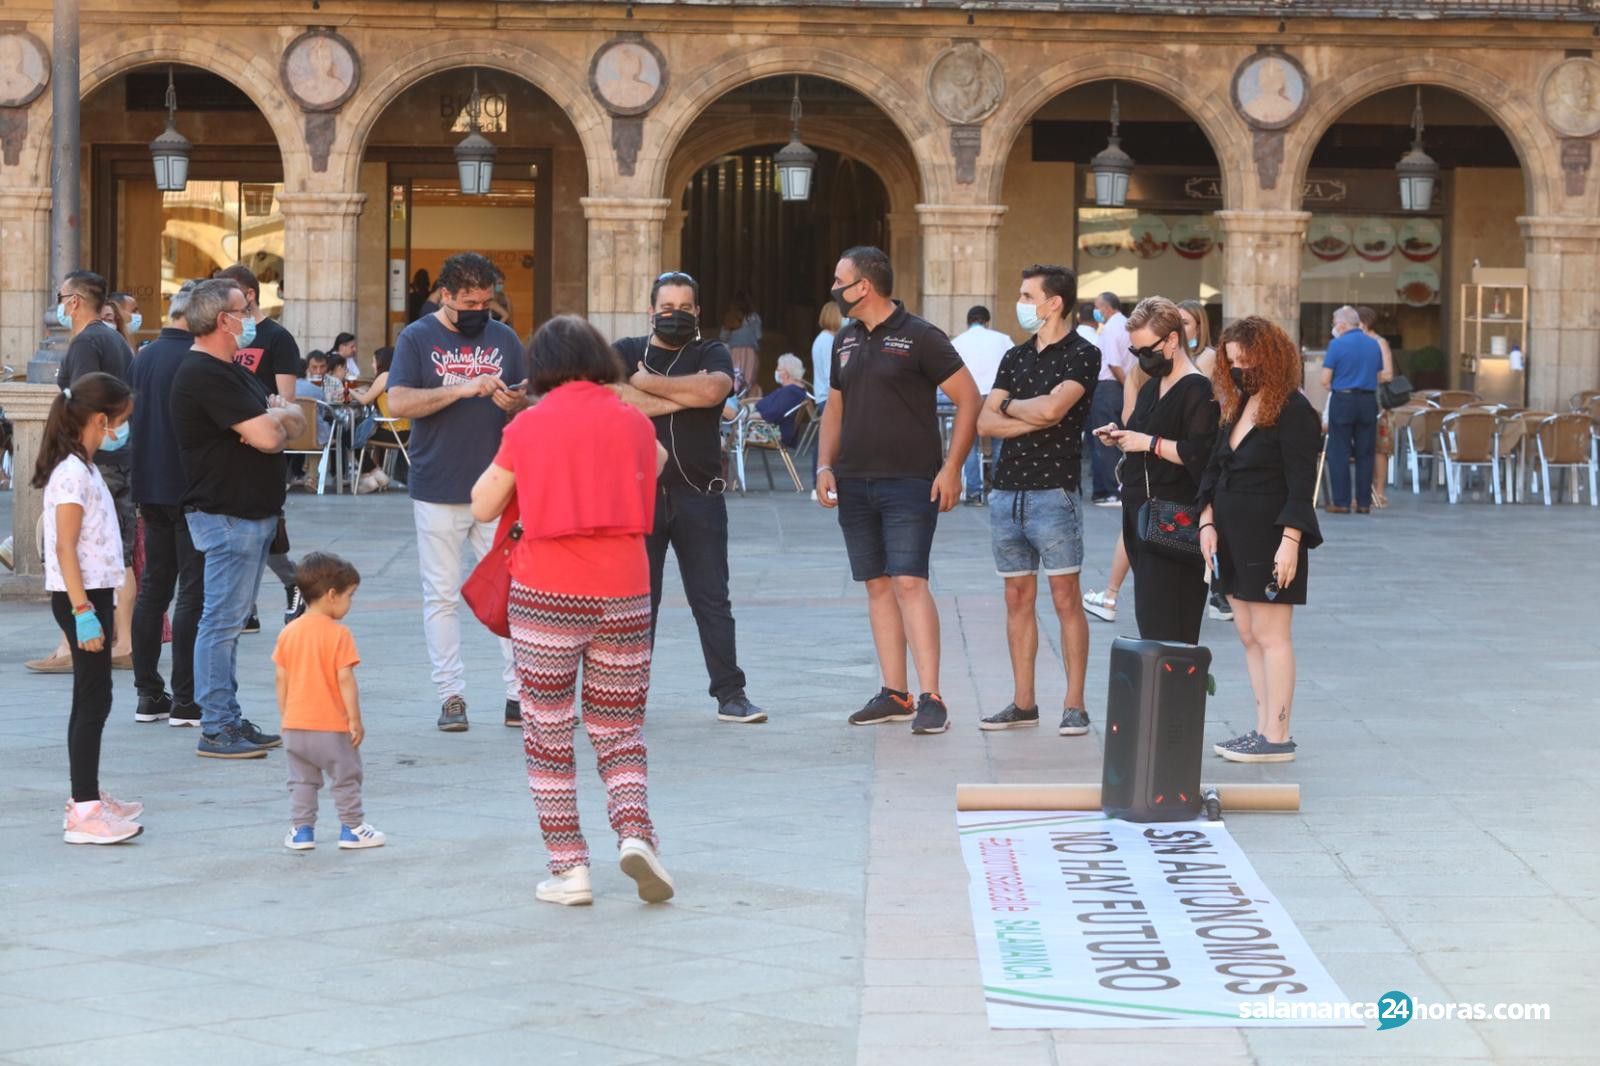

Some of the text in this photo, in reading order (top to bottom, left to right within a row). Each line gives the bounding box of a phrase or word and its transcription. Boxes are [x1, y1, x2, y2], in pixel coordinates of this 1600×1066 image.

[431, 346, 503, 377] Springfield
[993, 919, 1054, 981] SALAMANCA
[1049, 831, 1181, 991] NO HAY FUTURO
[1143, 828, 1308, 995] SIN AUTÓNOMOS
